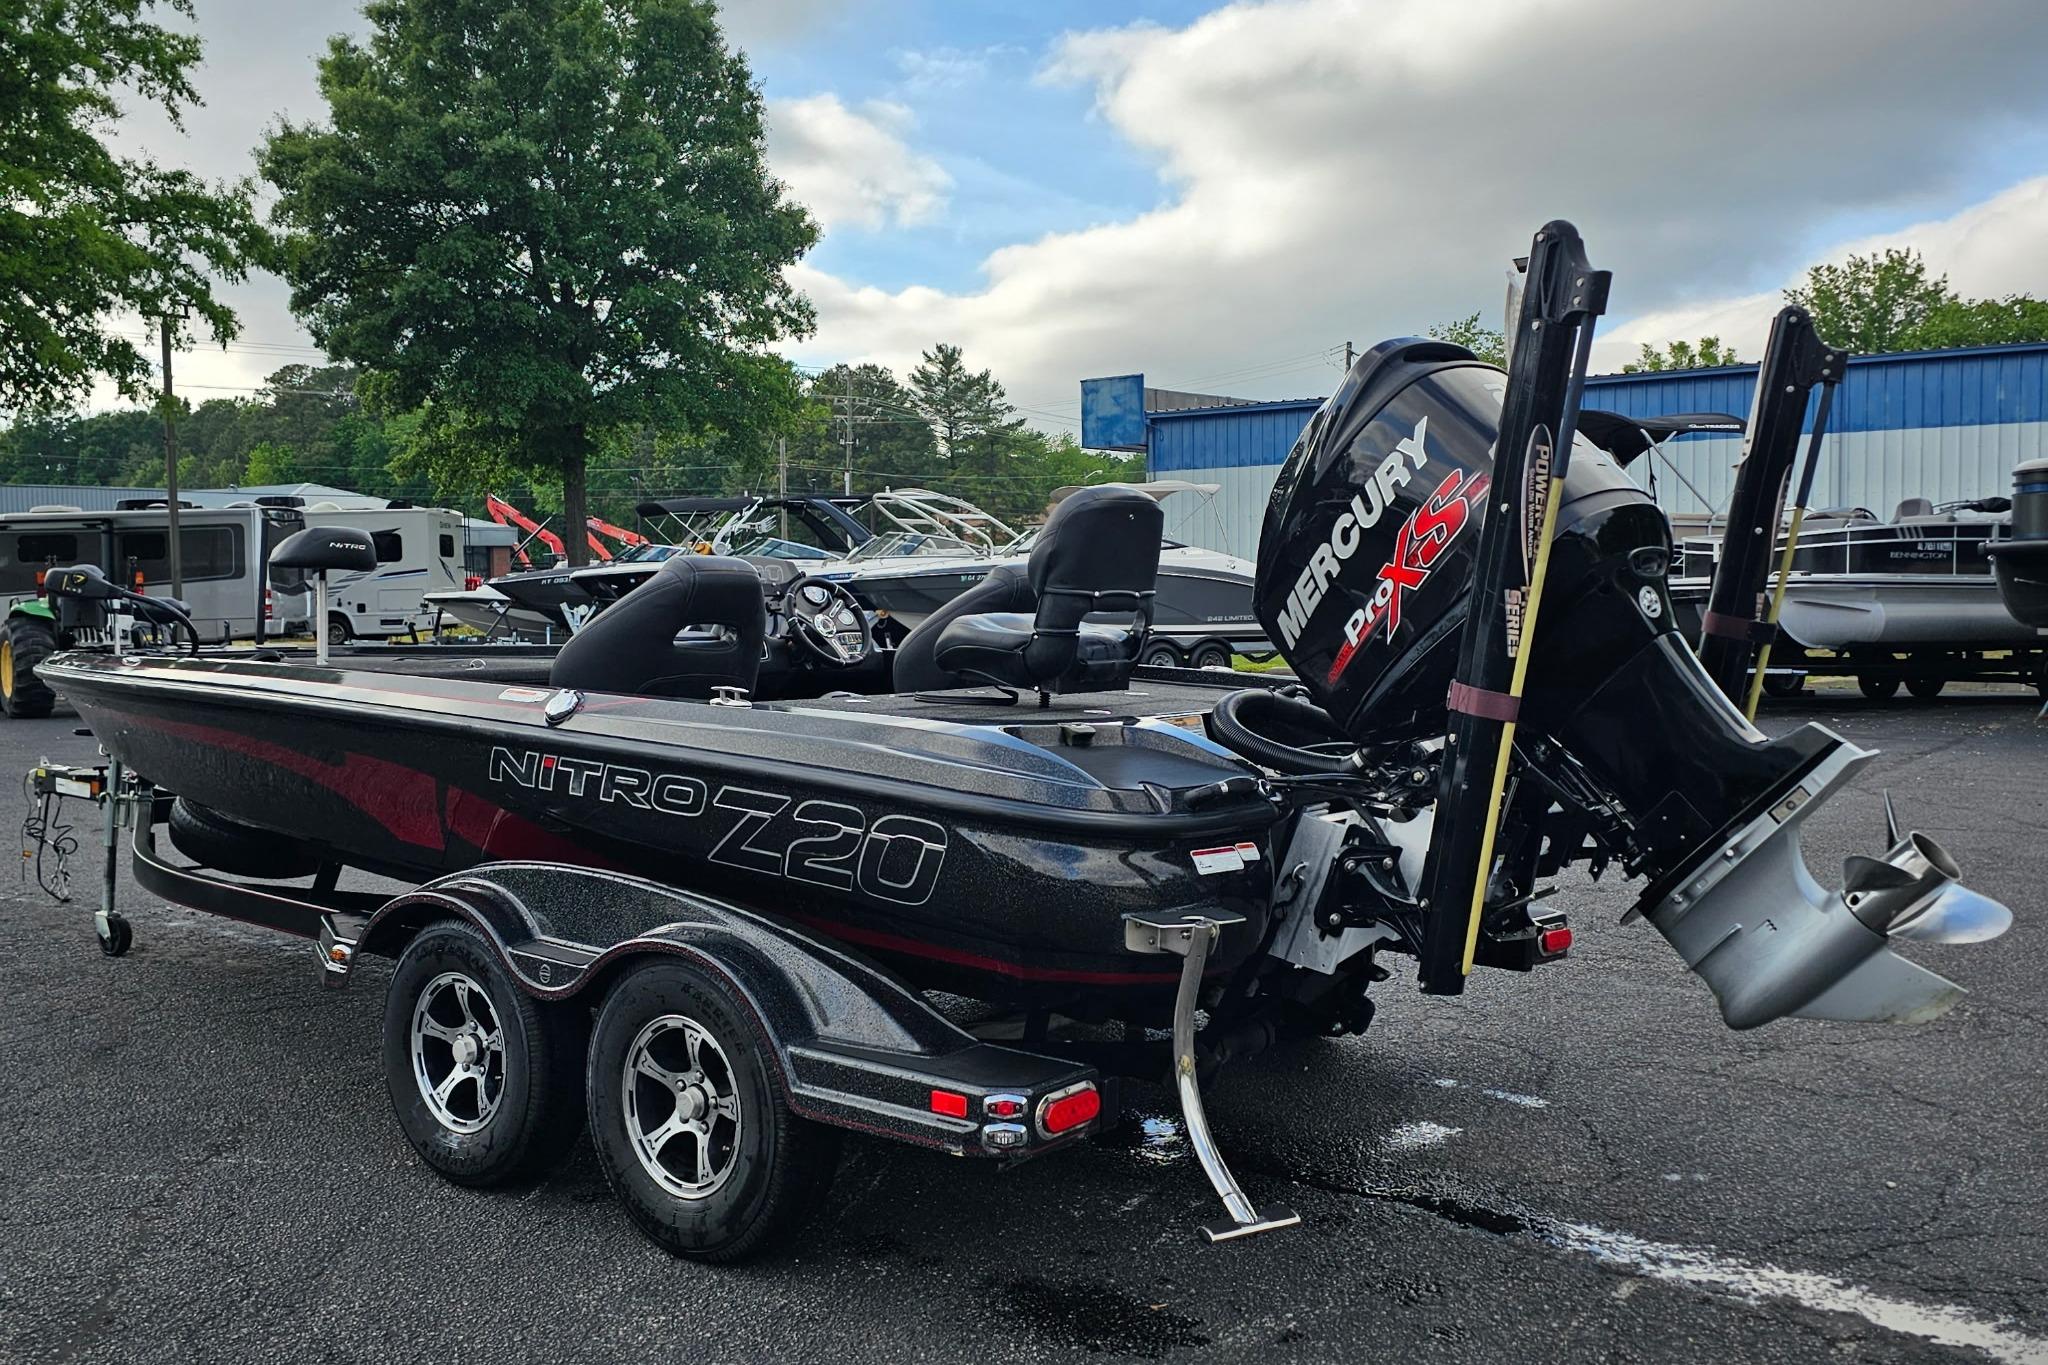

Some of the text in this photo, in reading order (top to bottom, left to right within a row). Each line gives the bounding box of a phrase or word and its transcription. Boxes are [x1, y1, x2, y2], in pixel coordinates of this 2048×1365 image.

[1275, 415, 1429, 652] MERCURY
[1889, 551, 1947, 559] BENNINGTON
[1224, 614, 1254, 622] LIMITED
[1503, 588, 1522, 658] SERIES
[488, 746, 948, 906] NITRO Z20
